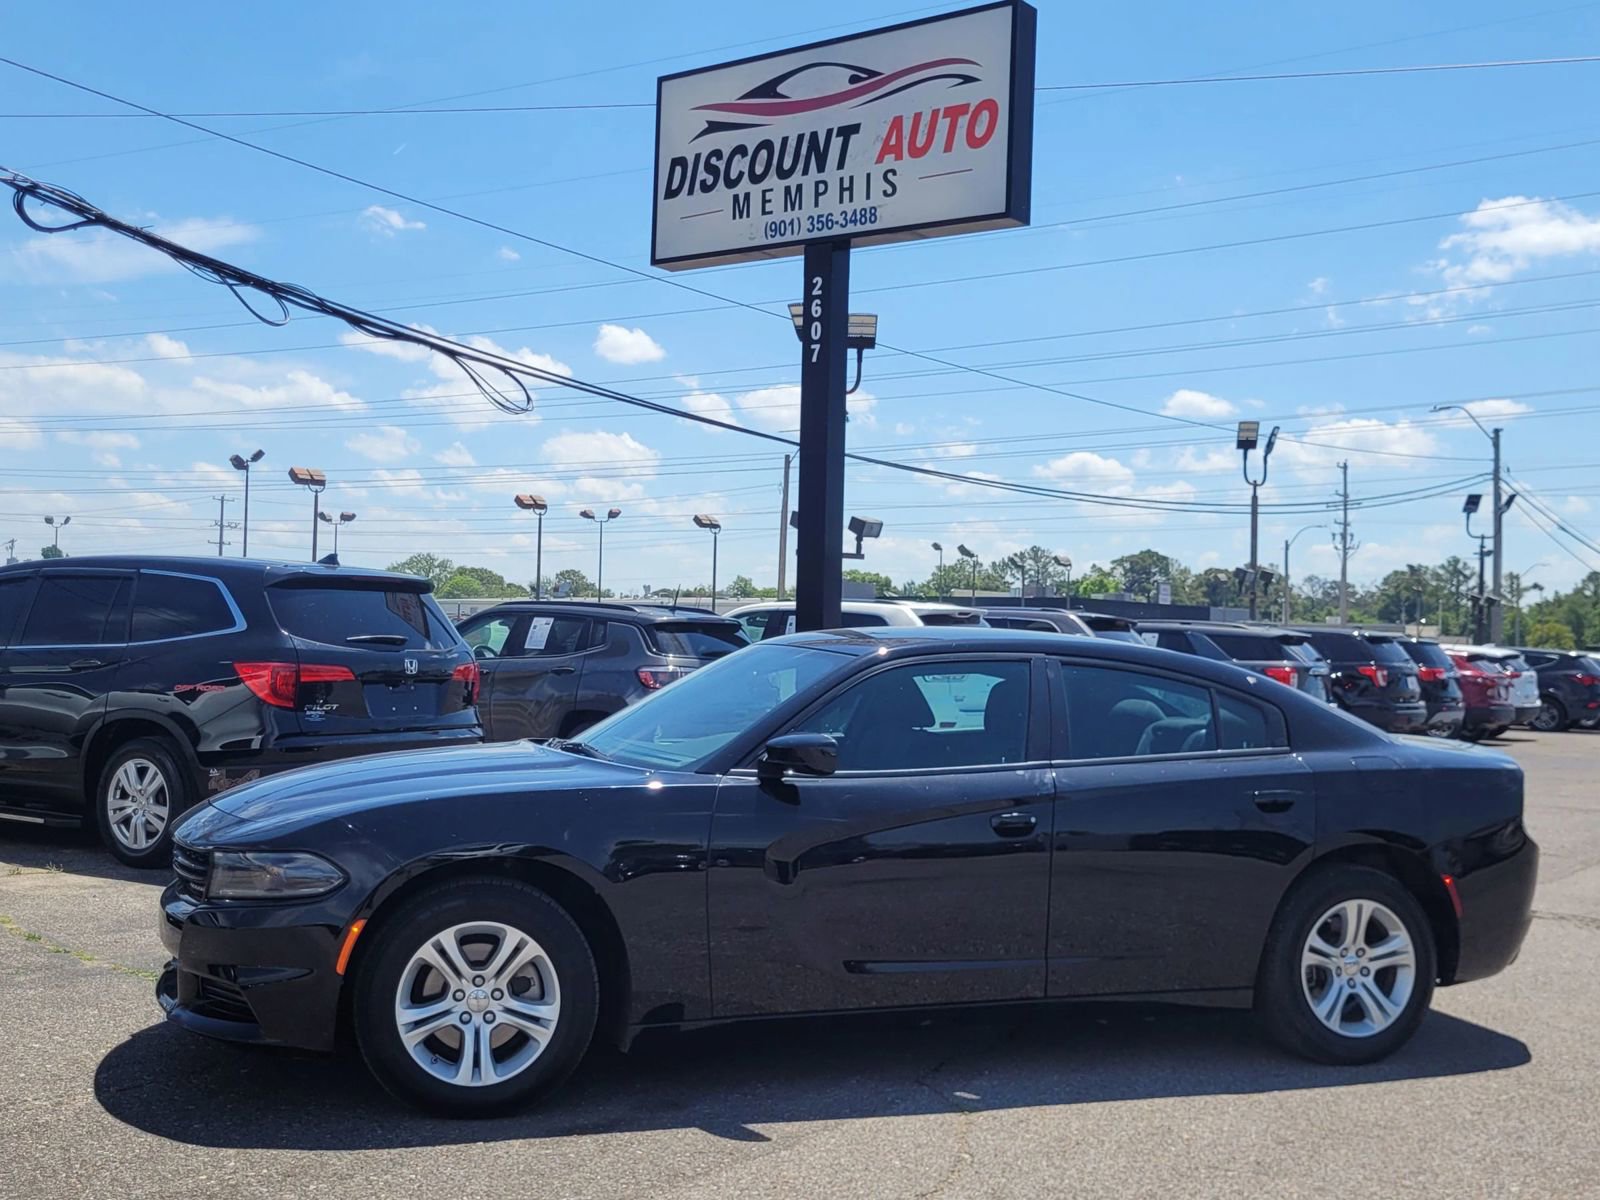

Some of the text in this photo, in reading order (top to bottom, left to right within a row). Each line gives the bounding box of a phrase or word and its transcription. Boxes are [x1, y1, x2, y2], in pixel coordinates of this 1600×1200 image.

[663, 98, 999, 200] DISCOUNT AUTO
[732, 168, 898, 220] MEMPHIS
[764, 206, 878, 240] (901) 356-3488
[810, 276, 823, 363] 2607
